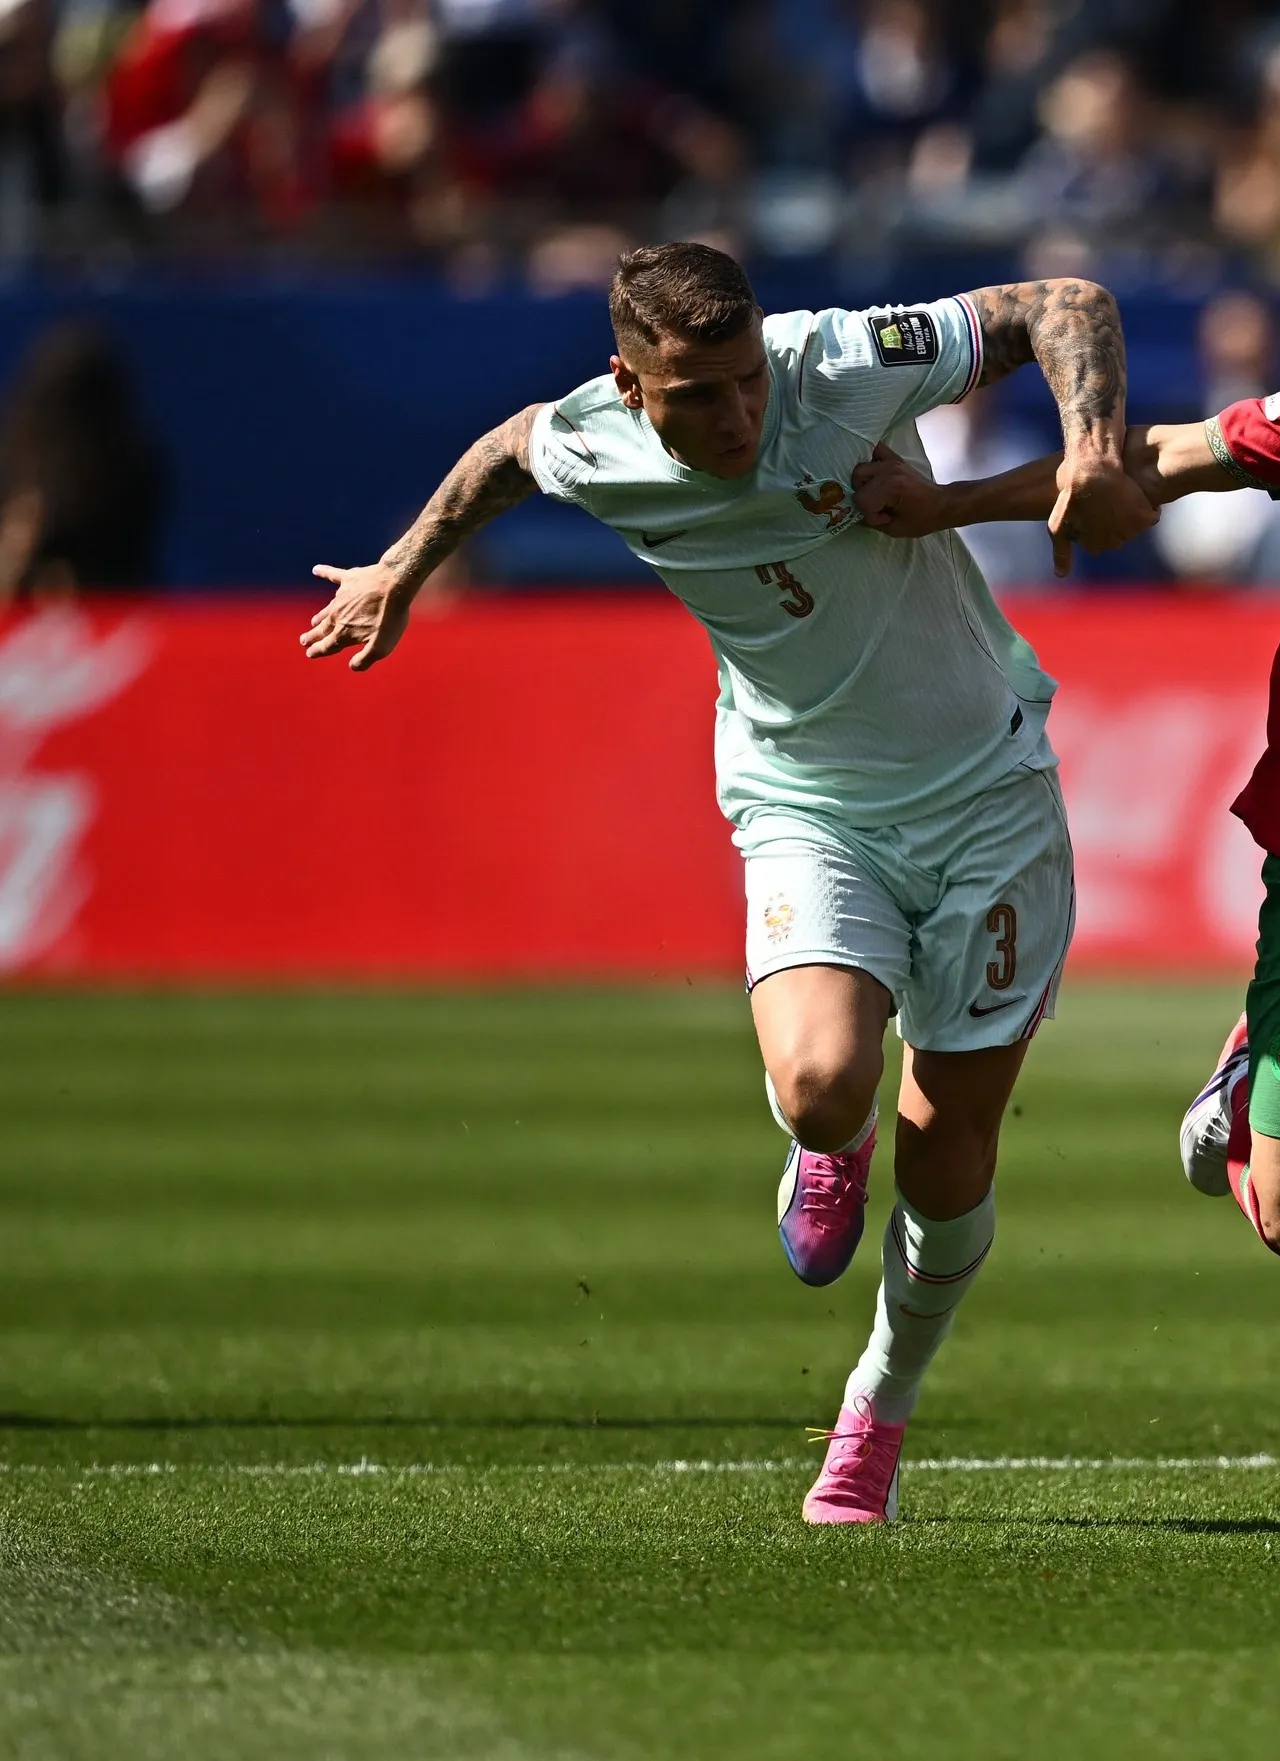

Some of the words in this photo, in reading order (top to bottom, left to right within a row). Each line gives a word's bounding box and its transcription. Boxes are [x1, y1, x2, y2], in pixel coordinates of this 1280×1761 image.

[908, 316, 927, 355] EDUCATION
[923, 327, 932, 342] FIFA
[754, 561, 815, 619] 3
[986, 903, 1017, 991] 3
